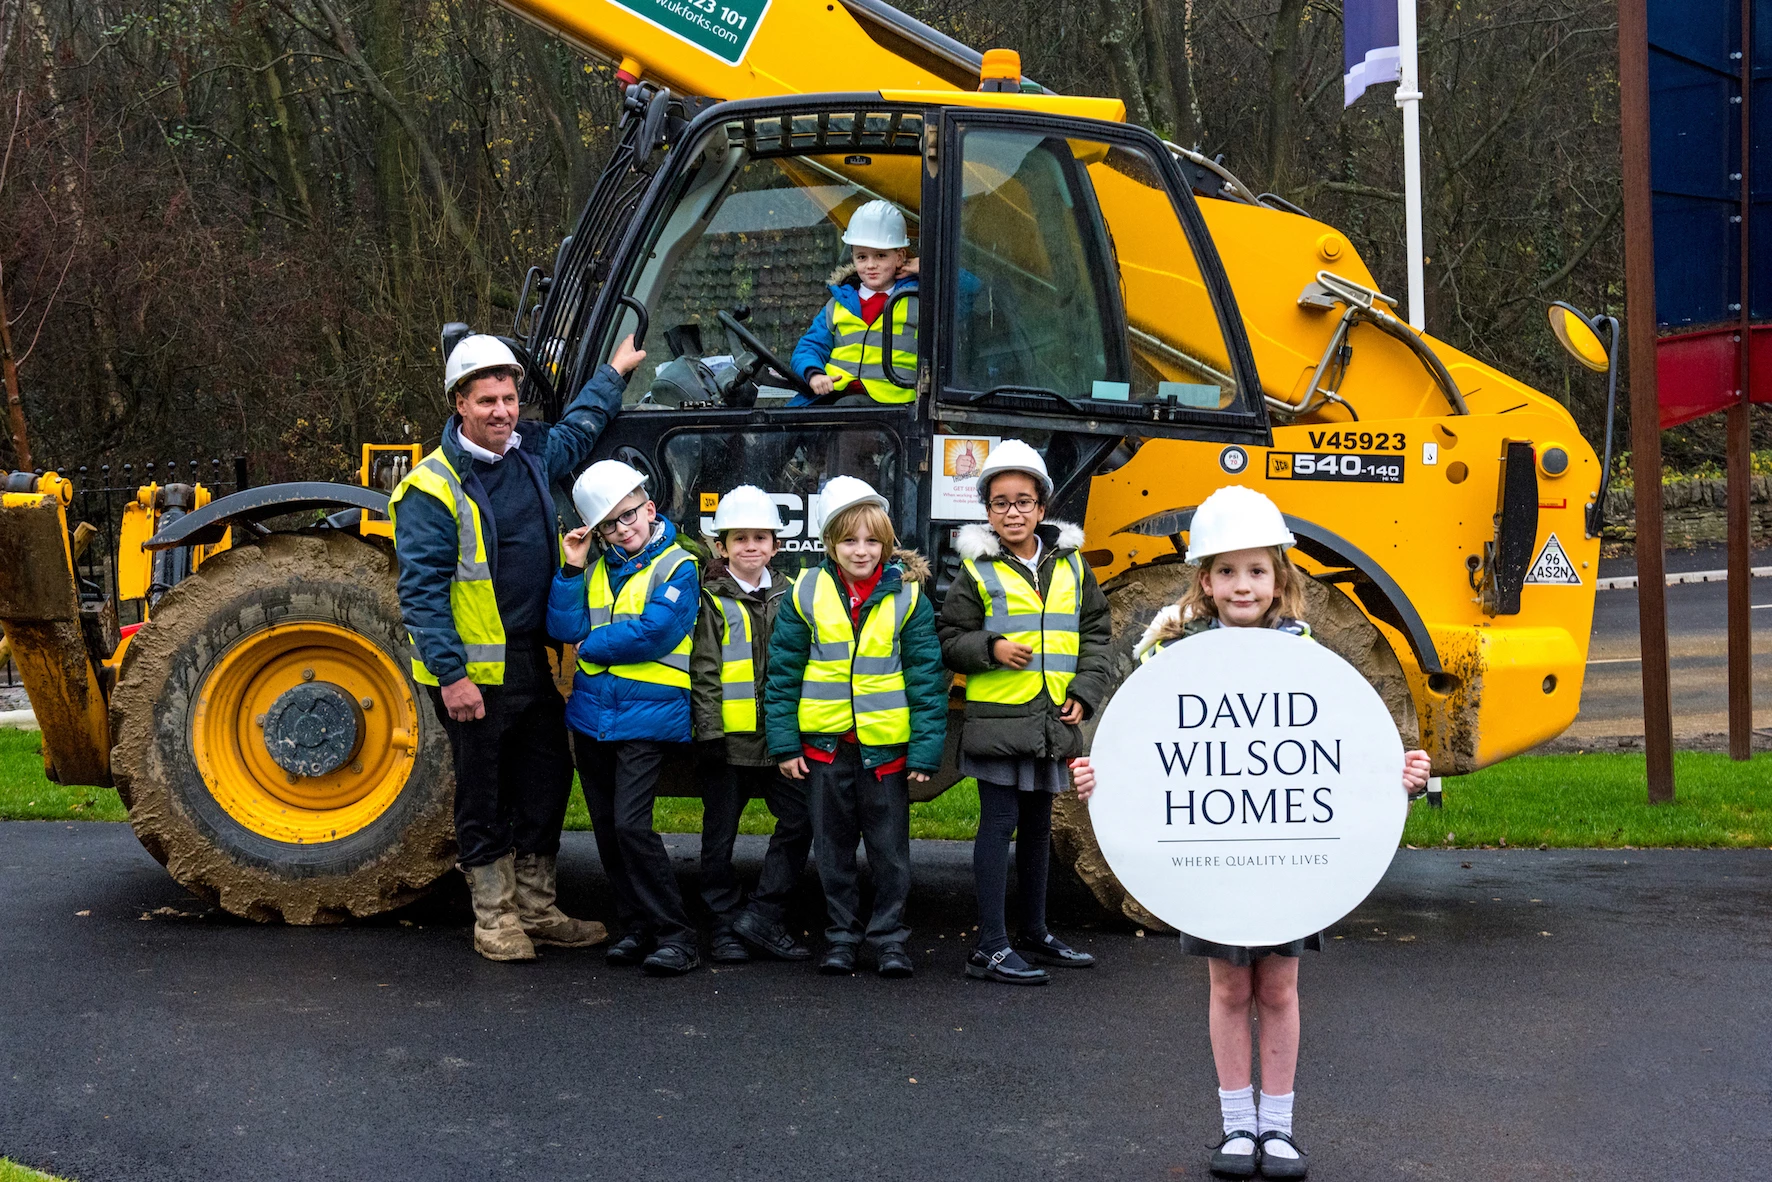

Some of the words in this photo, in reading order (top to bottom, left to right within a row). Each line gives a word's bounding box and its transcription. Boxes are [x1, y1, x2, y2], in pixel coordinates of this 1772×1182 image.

[688, 0, 717, 14] 23
[720, 6, 748, 31] 101
[1308, 431, 1406, 451] V45923
[1294, 453, 1400, 477] 540-140
[1545, 553, 1560, 566] 96
[1536, 566, 1569, 579] AS2N
[1177, 692, 1318, 729] DAVID
[1154, 739, 1341, 777] WILSON
[1165, 787, 1334, 826] HOMES
[1171, 856, 1221, 867] WHERE
[1225, 855, 1286, 867] QUALITY
[1291, 854, 1329, 865] LIVES
